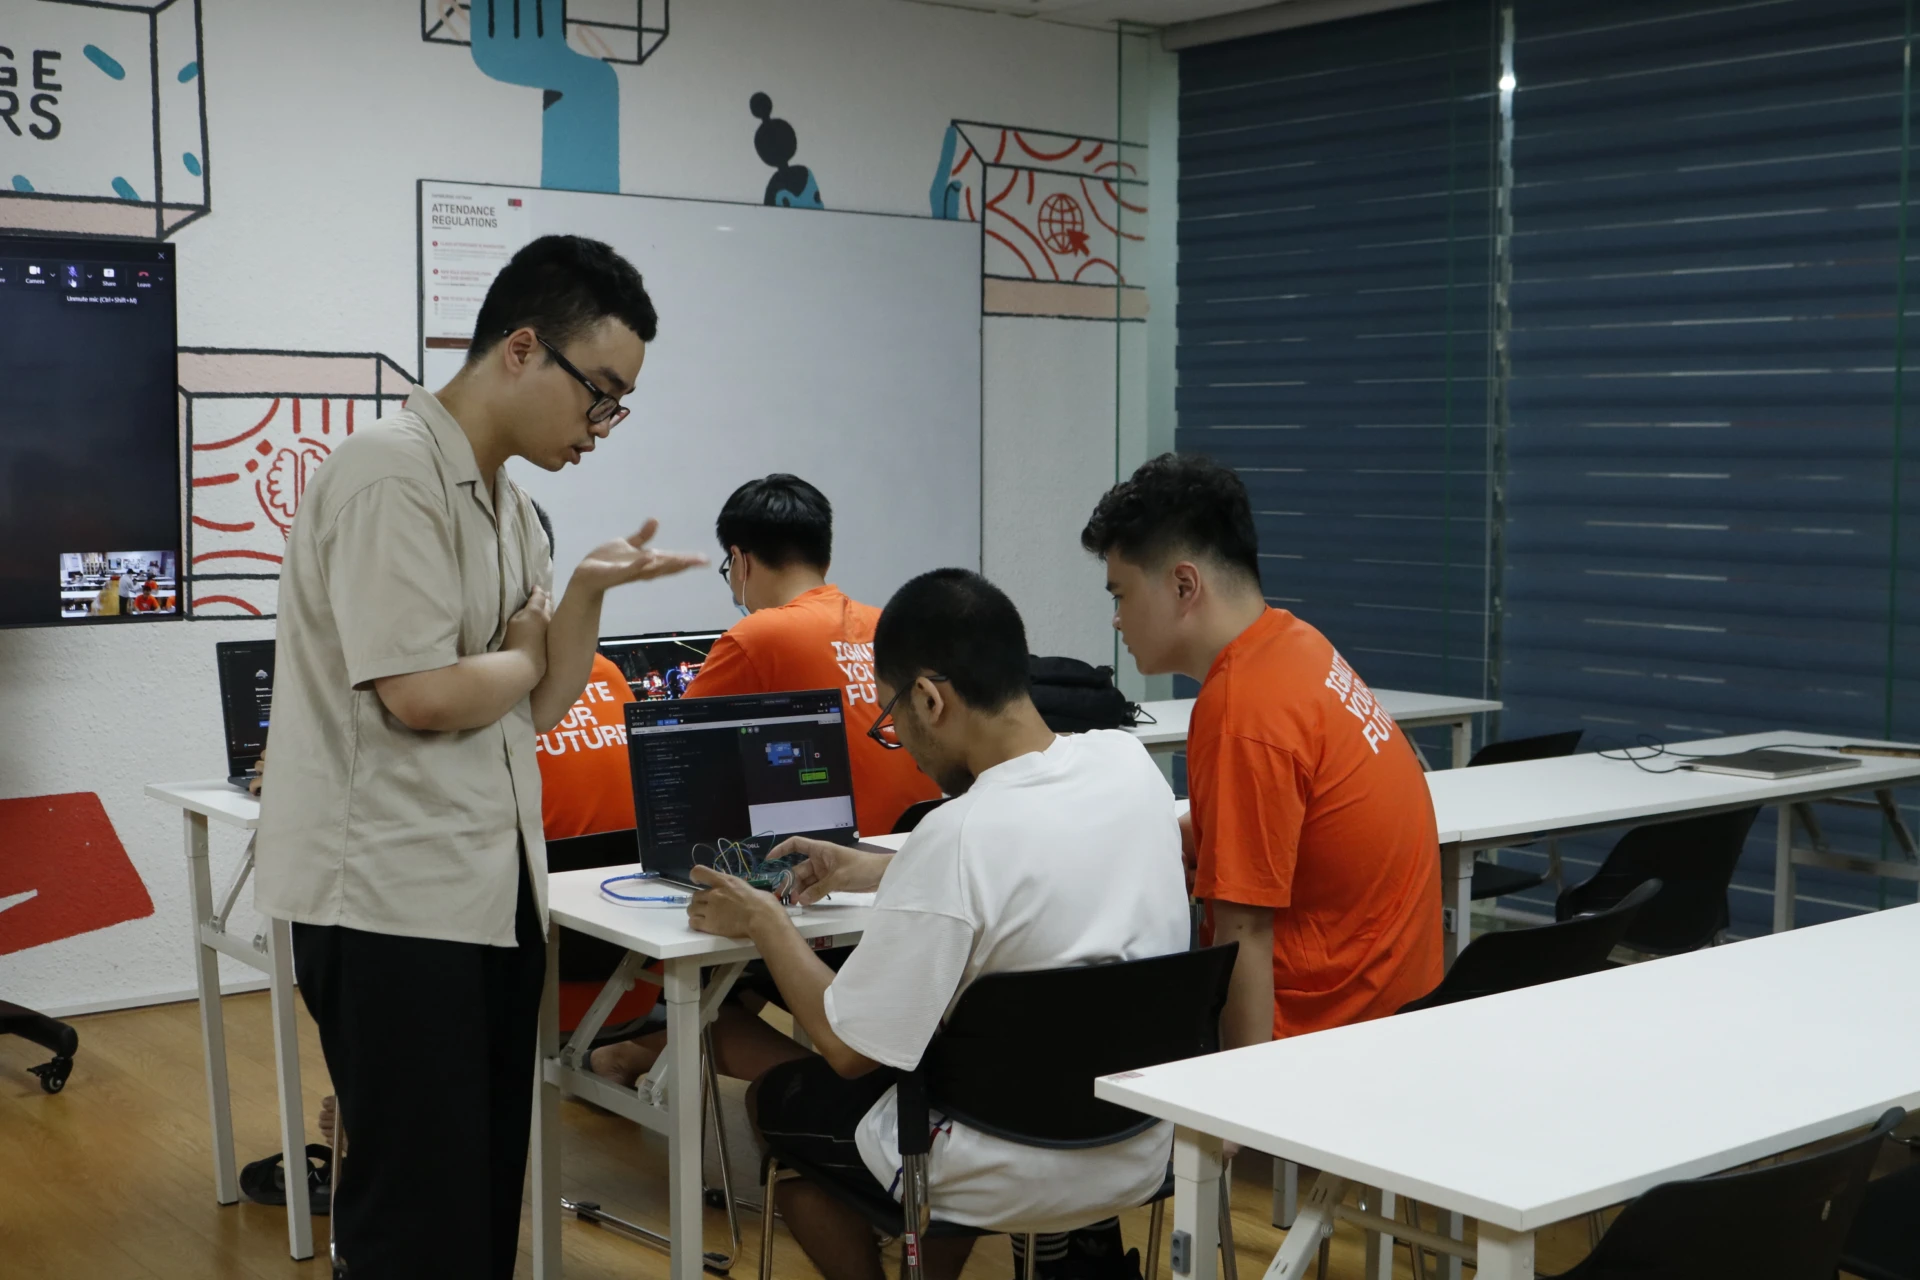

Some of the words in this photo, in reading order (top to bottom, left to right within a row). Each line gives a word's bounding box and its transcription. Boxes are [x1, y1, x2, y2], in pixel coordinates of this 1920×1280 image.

[432, 203, 496, 216] ATTENDANCE
[432, 215, 497, 228] REGULATIONS
[25, 277, 45, 285] Camera
[846, 683, 877, 706] FU
